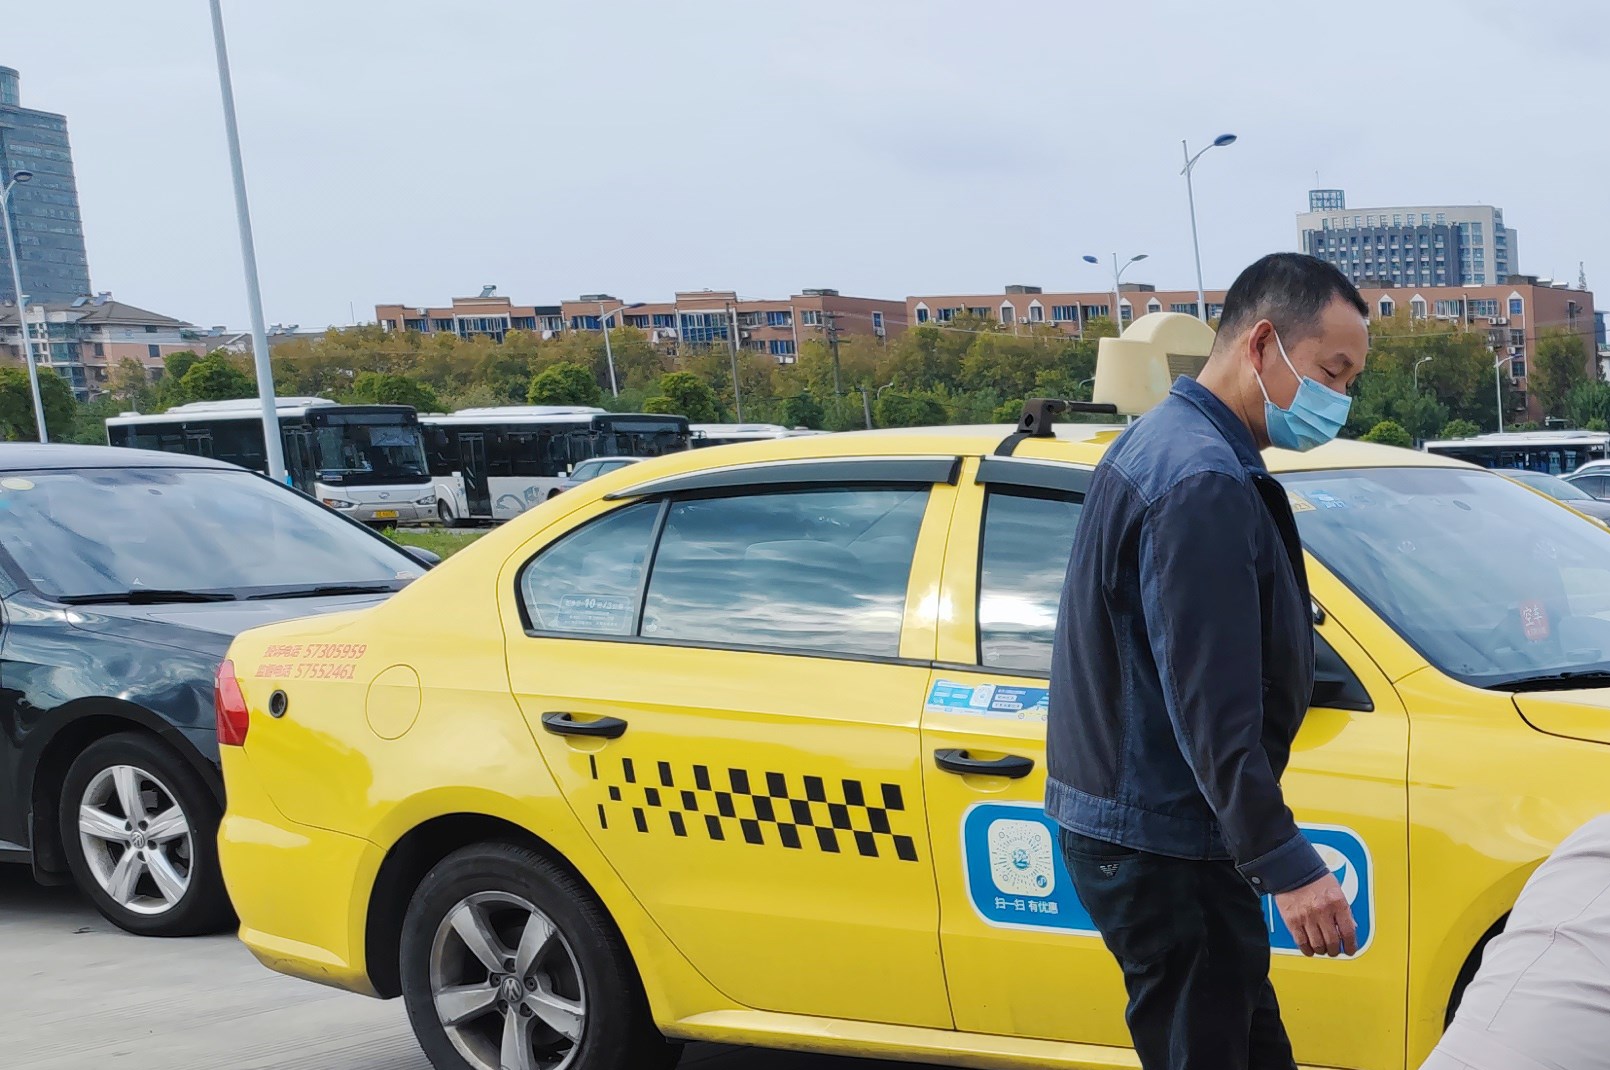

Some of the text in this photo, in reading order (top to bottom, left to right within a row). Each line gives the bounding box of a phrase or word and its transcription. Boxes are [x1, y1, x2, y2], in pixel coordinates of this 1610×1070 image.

[303, 644, 367, 659] 57305959
[294, 664, 356, 679] 57552461
[994, 896, 1058, 914] 扫一扫 有优惠
